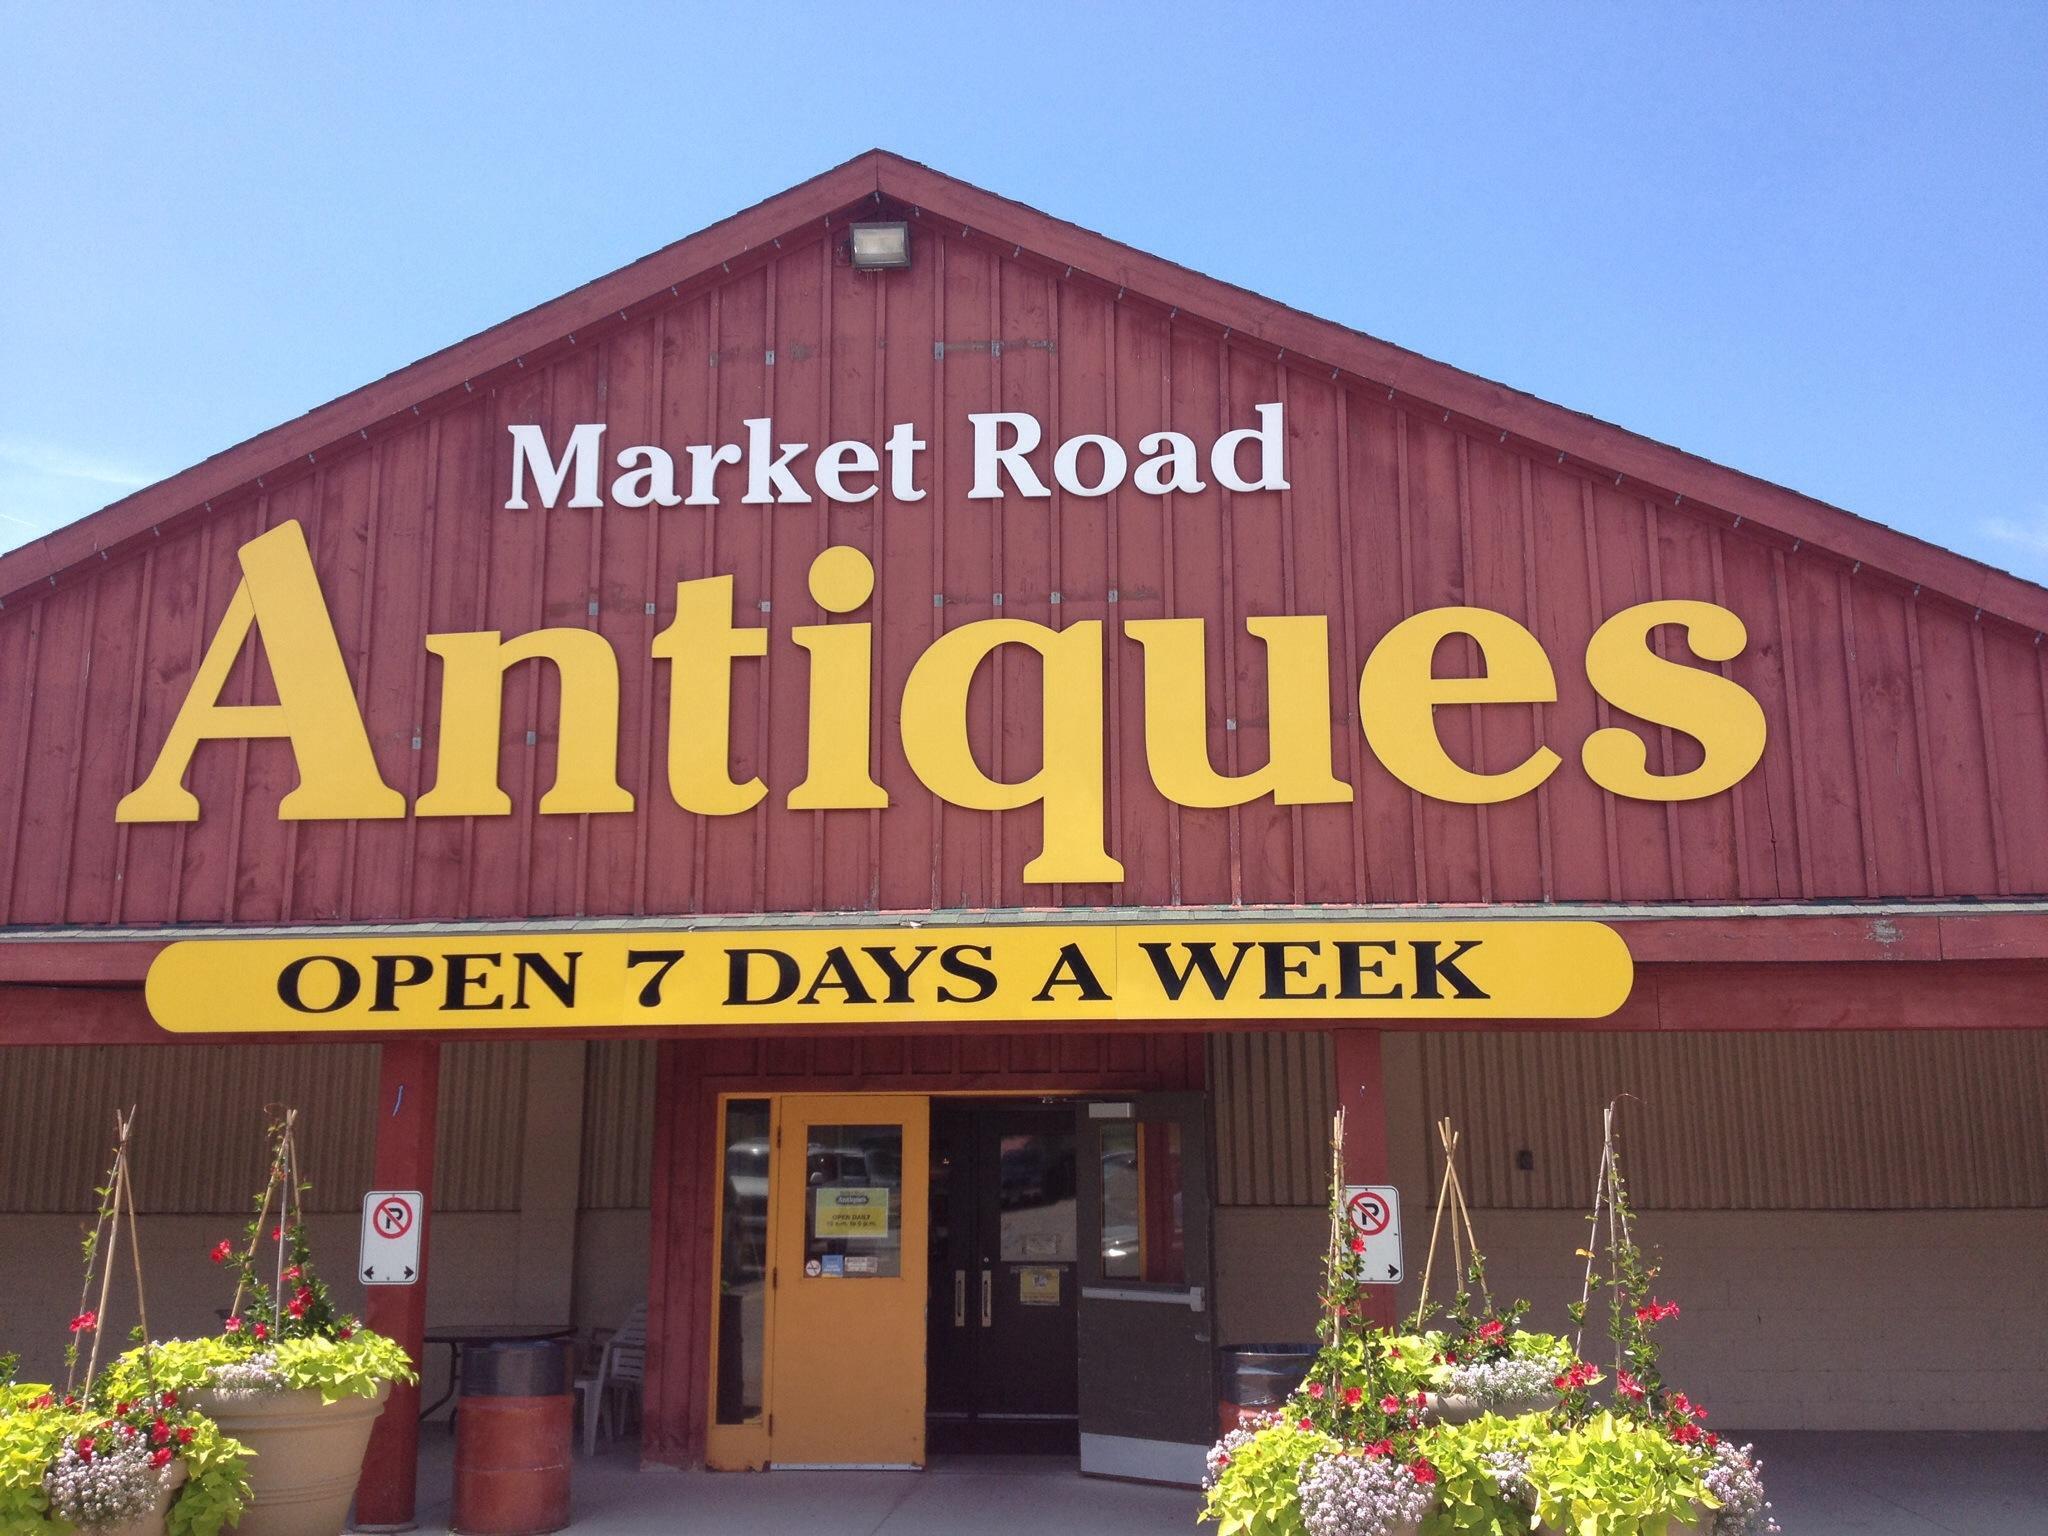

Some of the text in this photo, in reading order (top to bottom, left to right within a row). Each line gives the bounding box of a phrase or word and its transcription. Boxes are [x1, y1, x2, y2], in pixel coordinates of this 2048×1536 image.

[504, 402, 1291, 510] Market Road
[115, 519, 1767, 885] Antiques
[277, 940, 1491, 1014] OPEN 7 DAYS A WEEK
